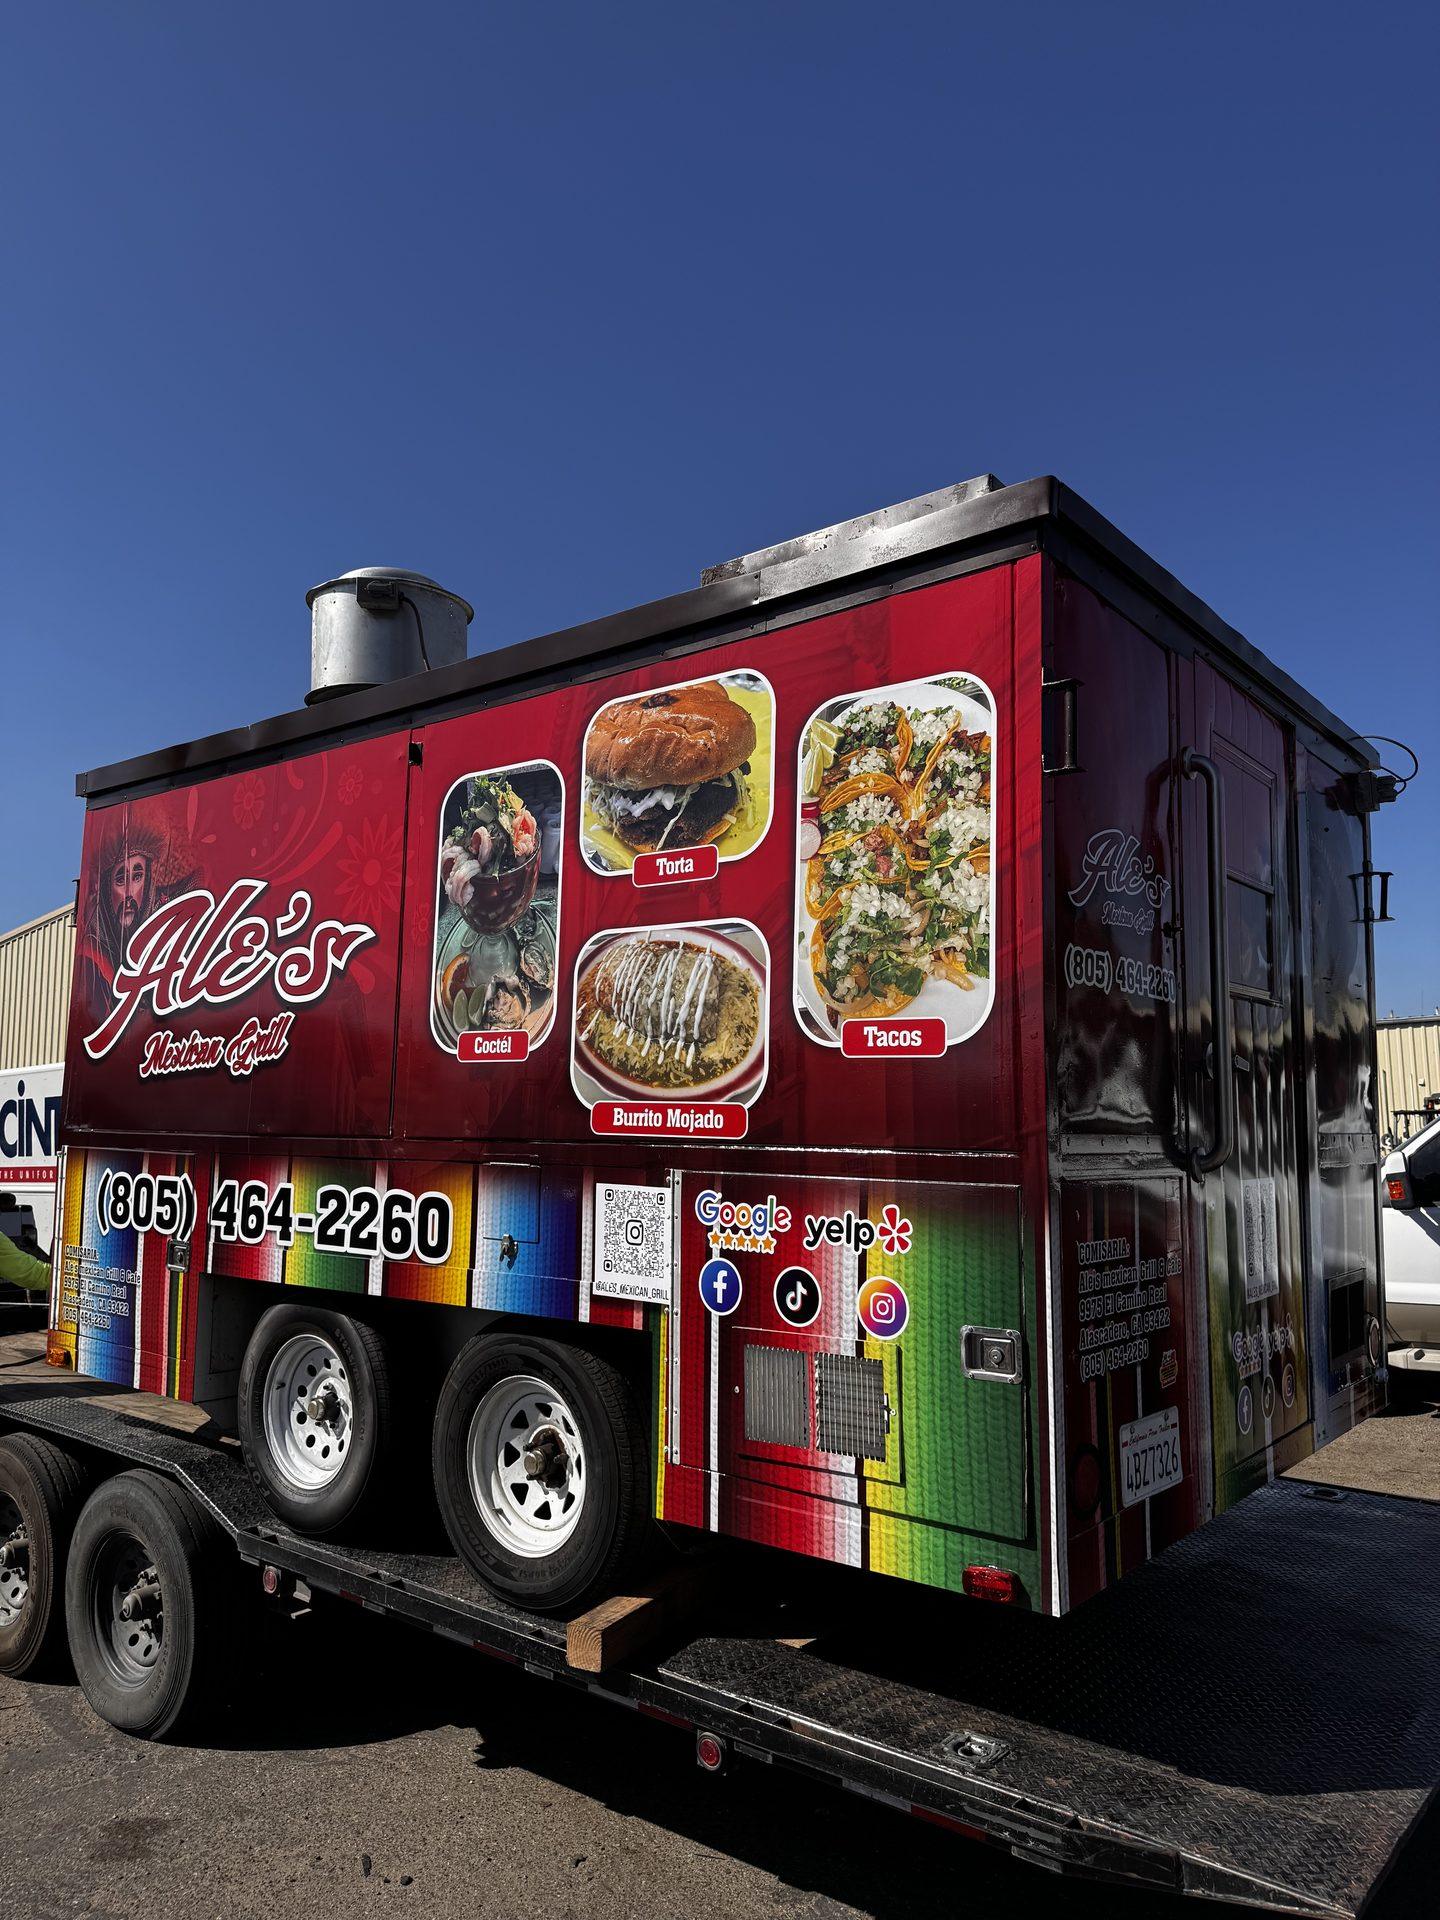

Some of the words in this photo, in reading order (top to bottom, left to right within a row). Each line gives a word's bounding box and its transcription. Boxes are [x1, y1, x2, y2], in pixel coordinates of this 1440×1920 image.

[655, 856, 695, 877] Torta
[1067, 828, 1171, 908] Ale's
[83, 878, 376, 1060] Ale's
[1064, 942, 1113, 995] (805)
[1116, 957, 1176, 1003] 464-2260
[140, 1030, 225, 1079] Mexican
[224, 1012, 296, 1076] Grill
[474, 1035, 512, 1054] Coctél
[863, 1025, 922, 1048] Tacos
[613, 1107, 663, 1128] Burrito
[666, 1108, 724, 1133] Mojado
[97, 1167, 198, 1242] (805)
[208, 1180, 453, 1264] 464-2260
[696, 1190, 792, 1237] Google
[803, 1211, 876, 1254] yelp
[1078, 1237, 1130, 1266] COMISARIA:
[64, 1275, 79, 1290] 9975
[80, 1278, 87, 1291] El
[87, 1280, 111, 1296] Camino
[111, 1284, 127, 1299] Real
[79, 1264, 105, 1279] mexican
[105, 1266, 119, 1281] Grill
[595, 1281, 669, 1300] @ALES_MEXICAN_GRILL
[1102, 1265, 1139, 1289] mexican
[1140, 1259, 1157, 1281] Grill
[98, 1299, 107, 1311] CA
[107, 1300, 129, 1316] 93422
[1079, 1296, 1103, 1322] 9975
[1104, 1293, 1115, 1316] El
[1115, 1289, 1147, 1313] Camino
[1148, 1282, 1168, 1306] Real
[1079, 1321, 1130, 1351] Atascadero,
[1131, 1314, 1143, 1336] CA
[1144, 1307, 1170, 1332] 93422
[1080, 1350, 1105, 1383] (805)
[1107, 1339, 1149, 1370] 464-2260
[1126, 1437, 1179, 1492] 4BZ7326
